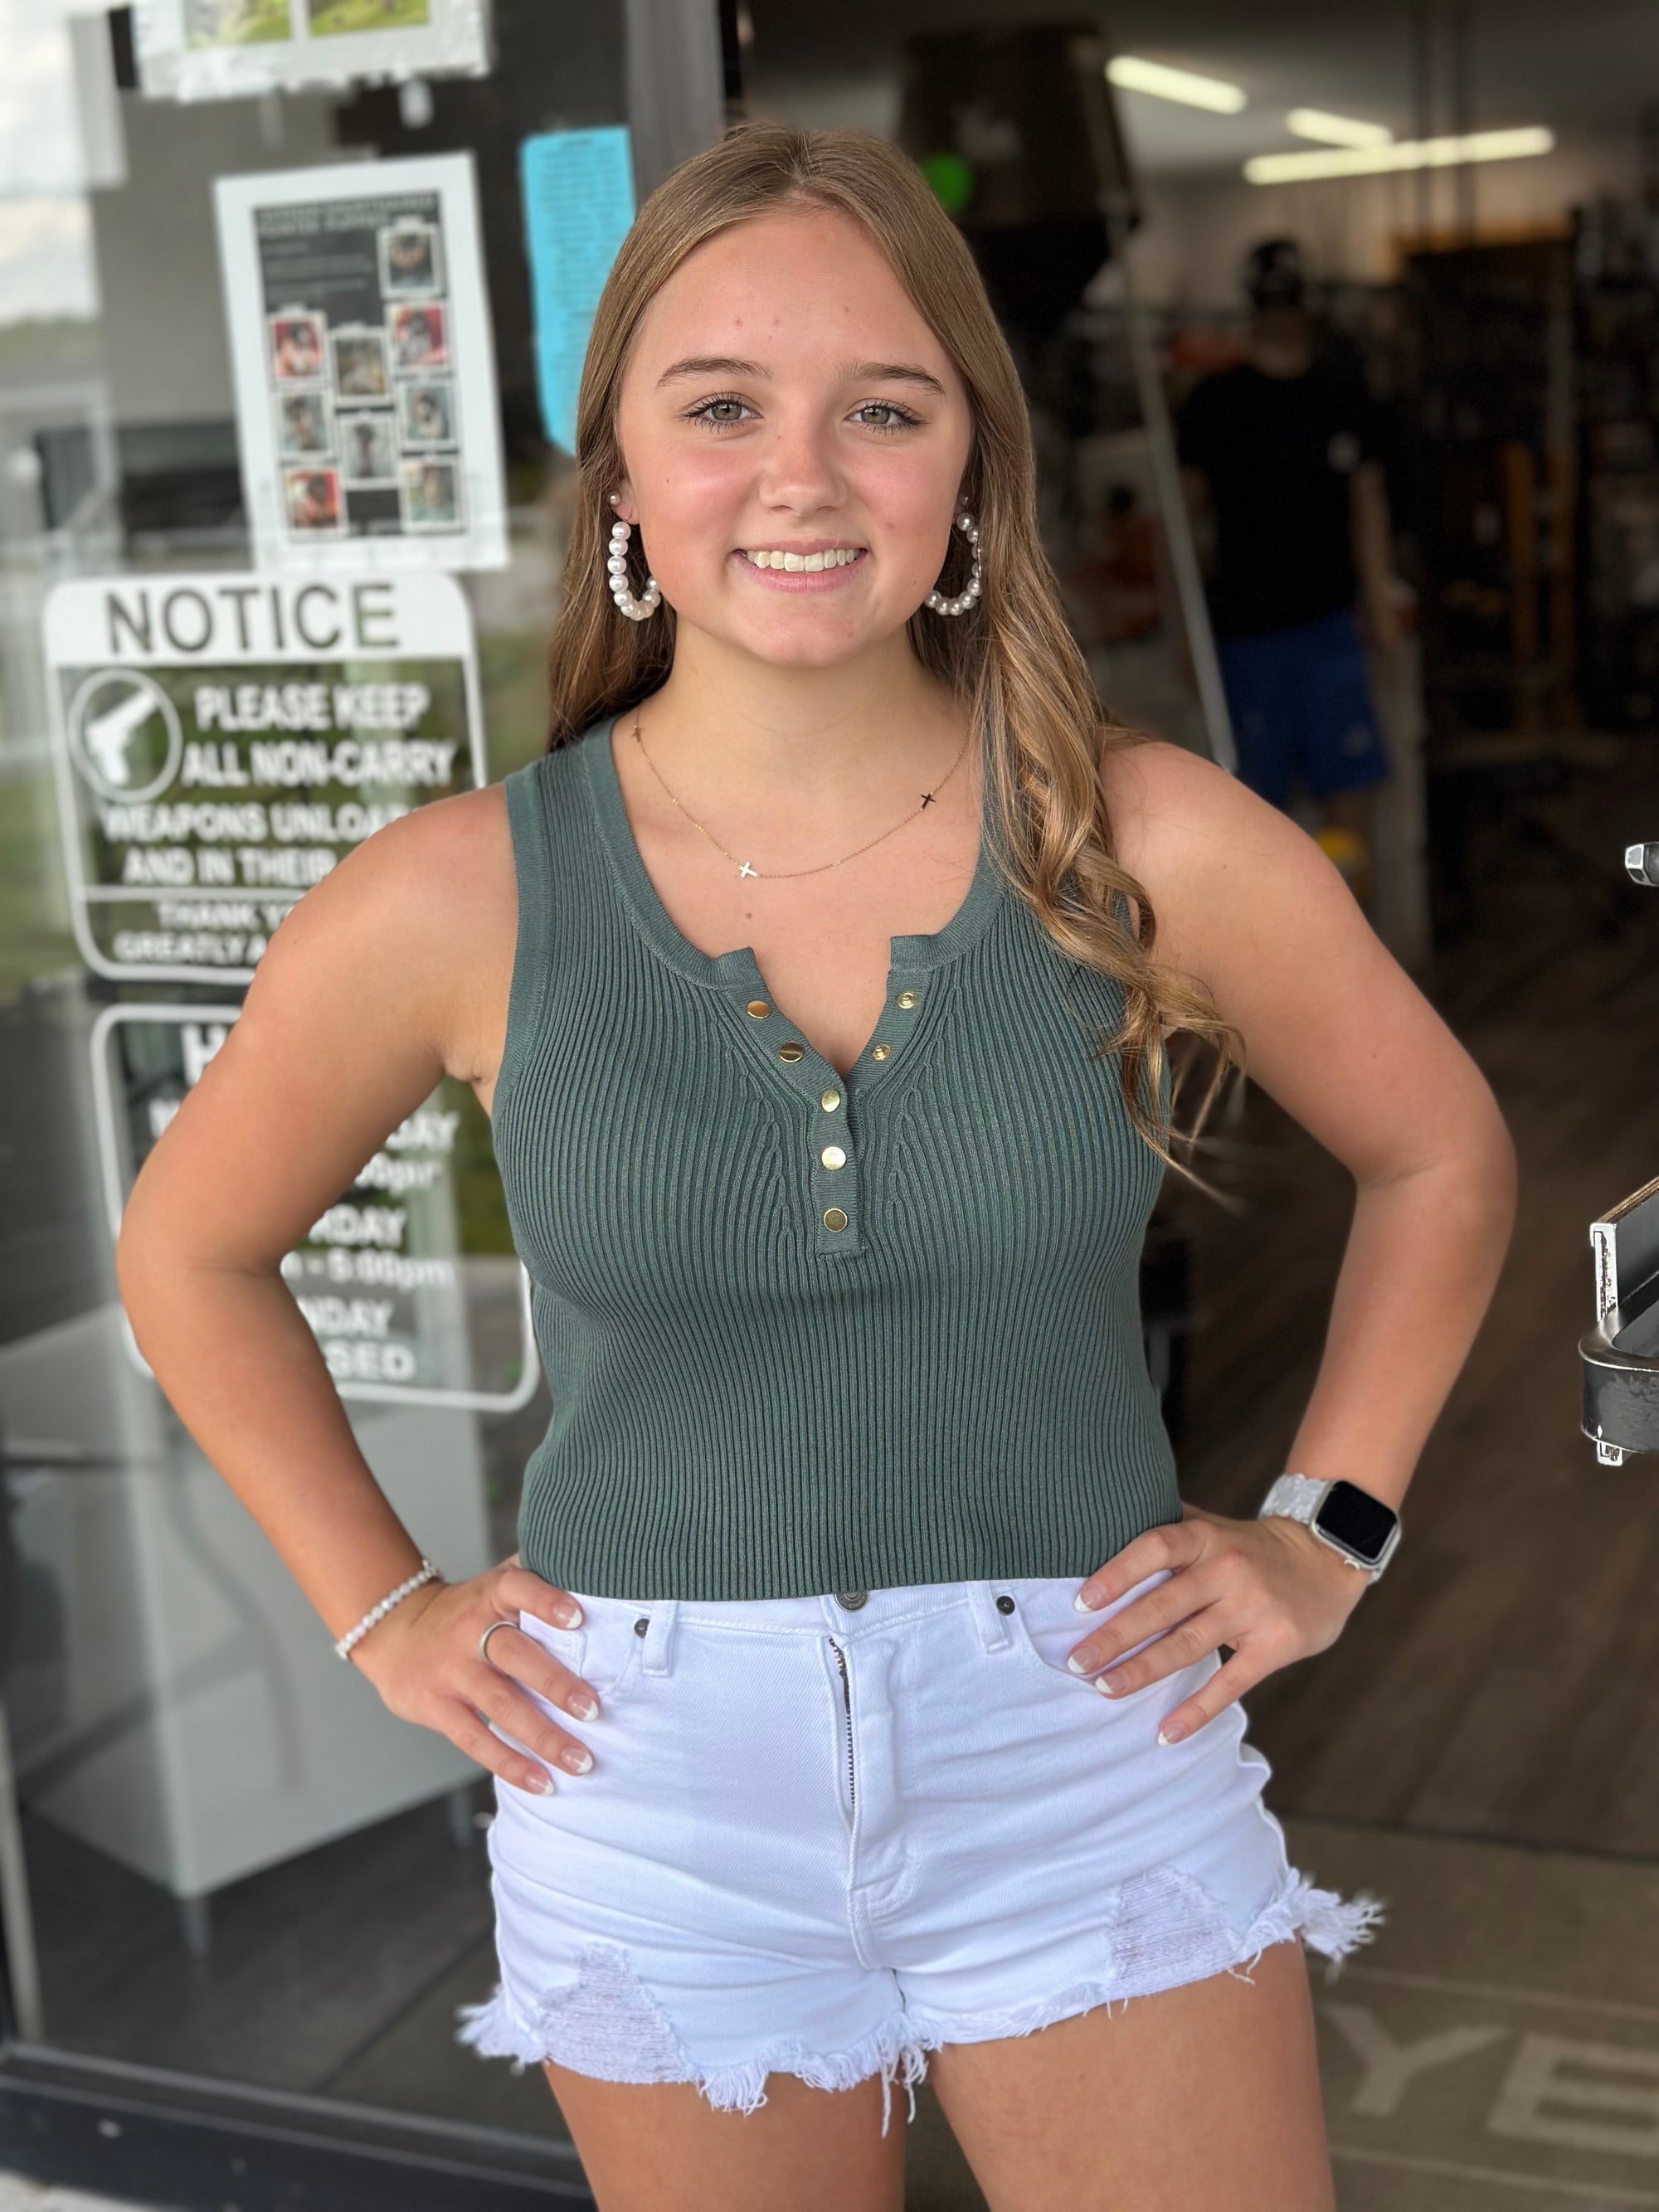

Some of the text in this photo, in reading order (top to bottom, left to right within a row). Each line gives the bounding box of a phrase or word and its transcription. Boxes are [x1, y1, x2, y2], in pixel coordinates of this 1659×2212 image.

[105, 583, 401, 654] NOTICE
[194, 683, 430, 731] PLEASE KEEP
[182, 741, 456, 787] ALL NON-CARRY
[105, 802, 268, 843] WEAPONS
[124, 846, 338, 887] AND IN THEIR
[155, 902, 261, 930] THANK
[114, 931, 248, 964] GREATLY
[385, 1111, 460, 1150] DAY
[322, 1339, 416, 1382] SED
